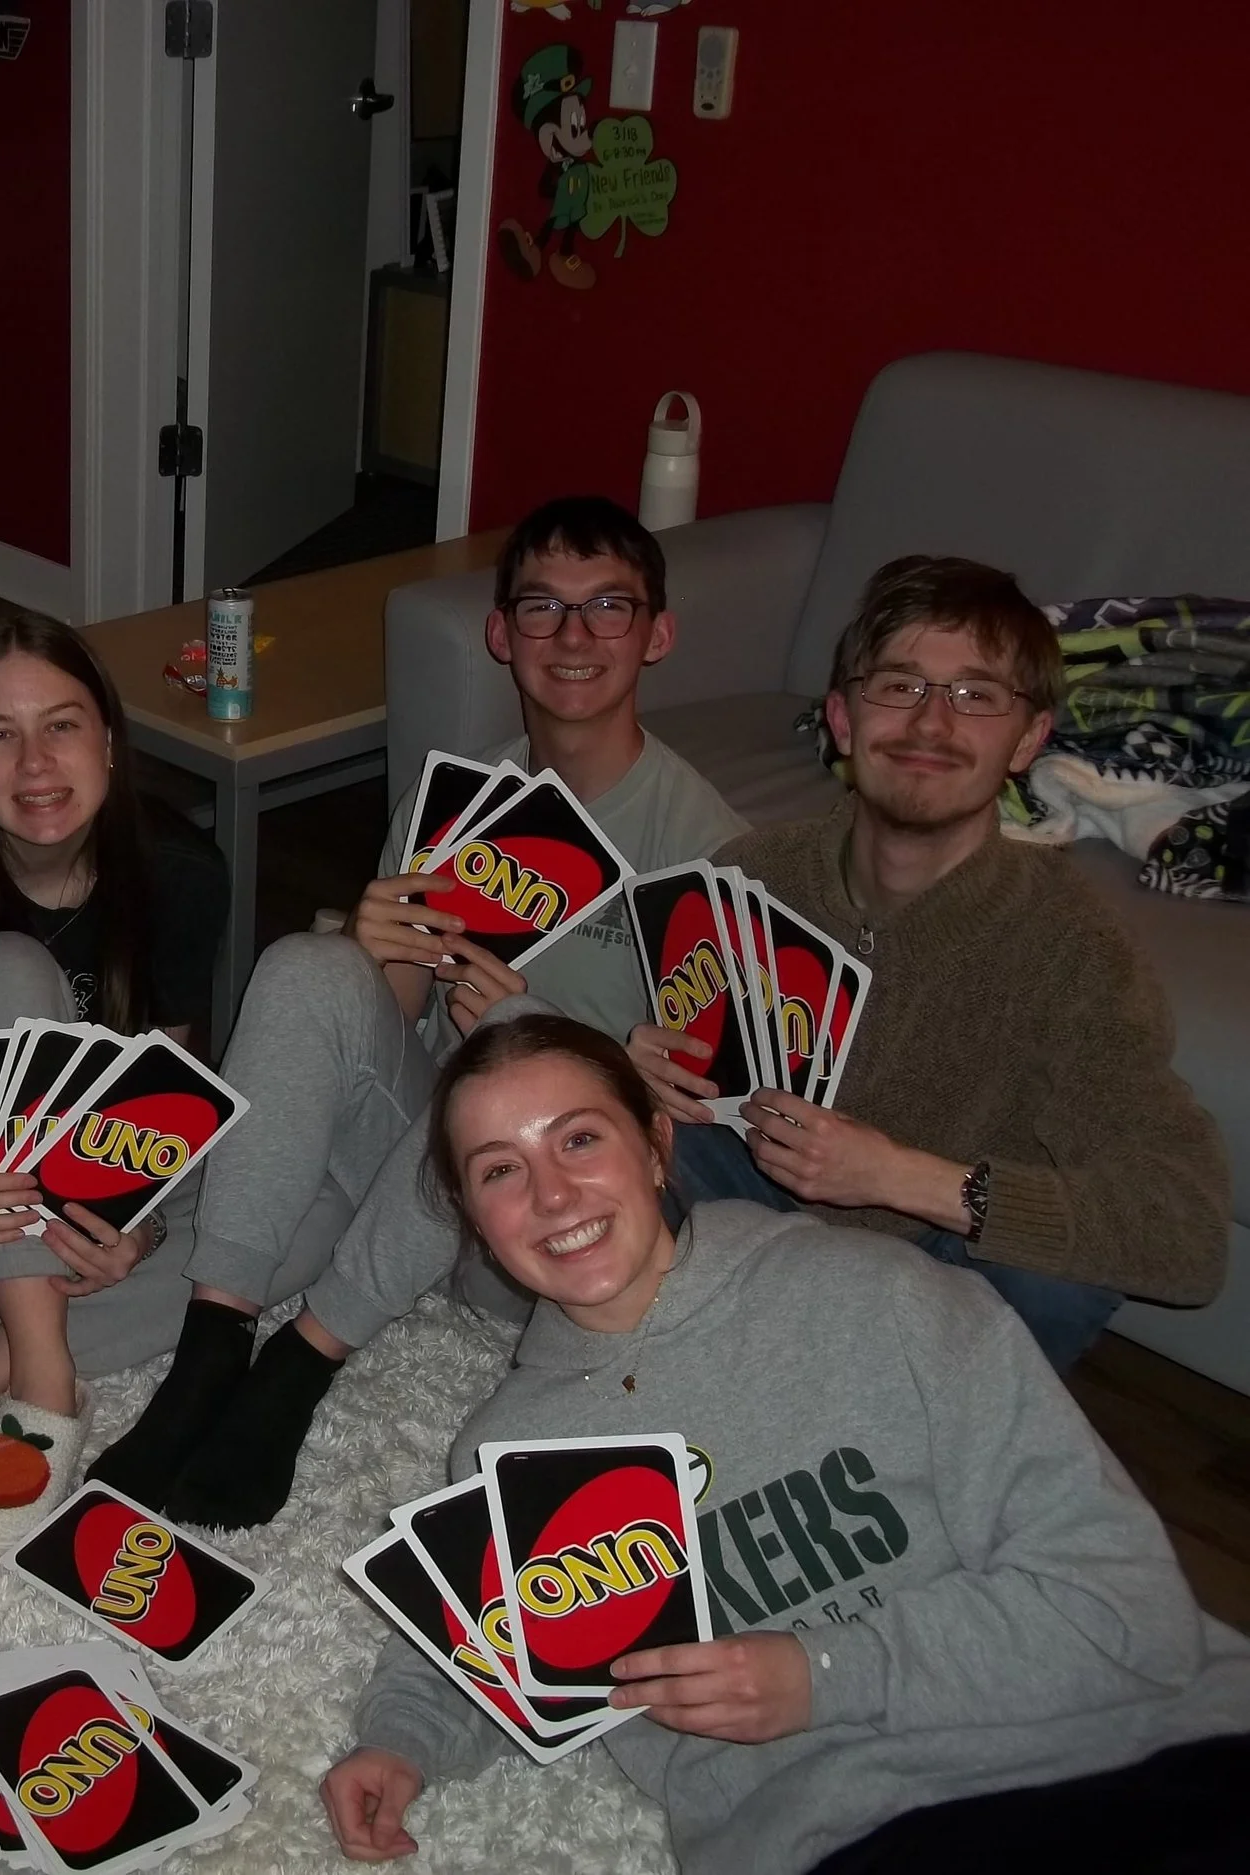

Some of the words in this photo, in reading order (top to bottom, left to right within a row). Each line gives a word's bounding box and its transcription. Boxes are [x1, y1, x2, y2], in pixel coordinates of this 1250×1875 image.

[592, 173, 618, 194] New
[623, 163, 670, 189] Friends
[455, 840, 569, 934] UNO
[571, 923, 632, 947] INNESO
[657, 939, 731, 1031] UNO
[70, 1112, 190, 1181] UNO
[89, 1520, 177, 1623] UNO
[515, 1519, 690, 1618] UNO
[16, 1716, 141, 1818] UNO
